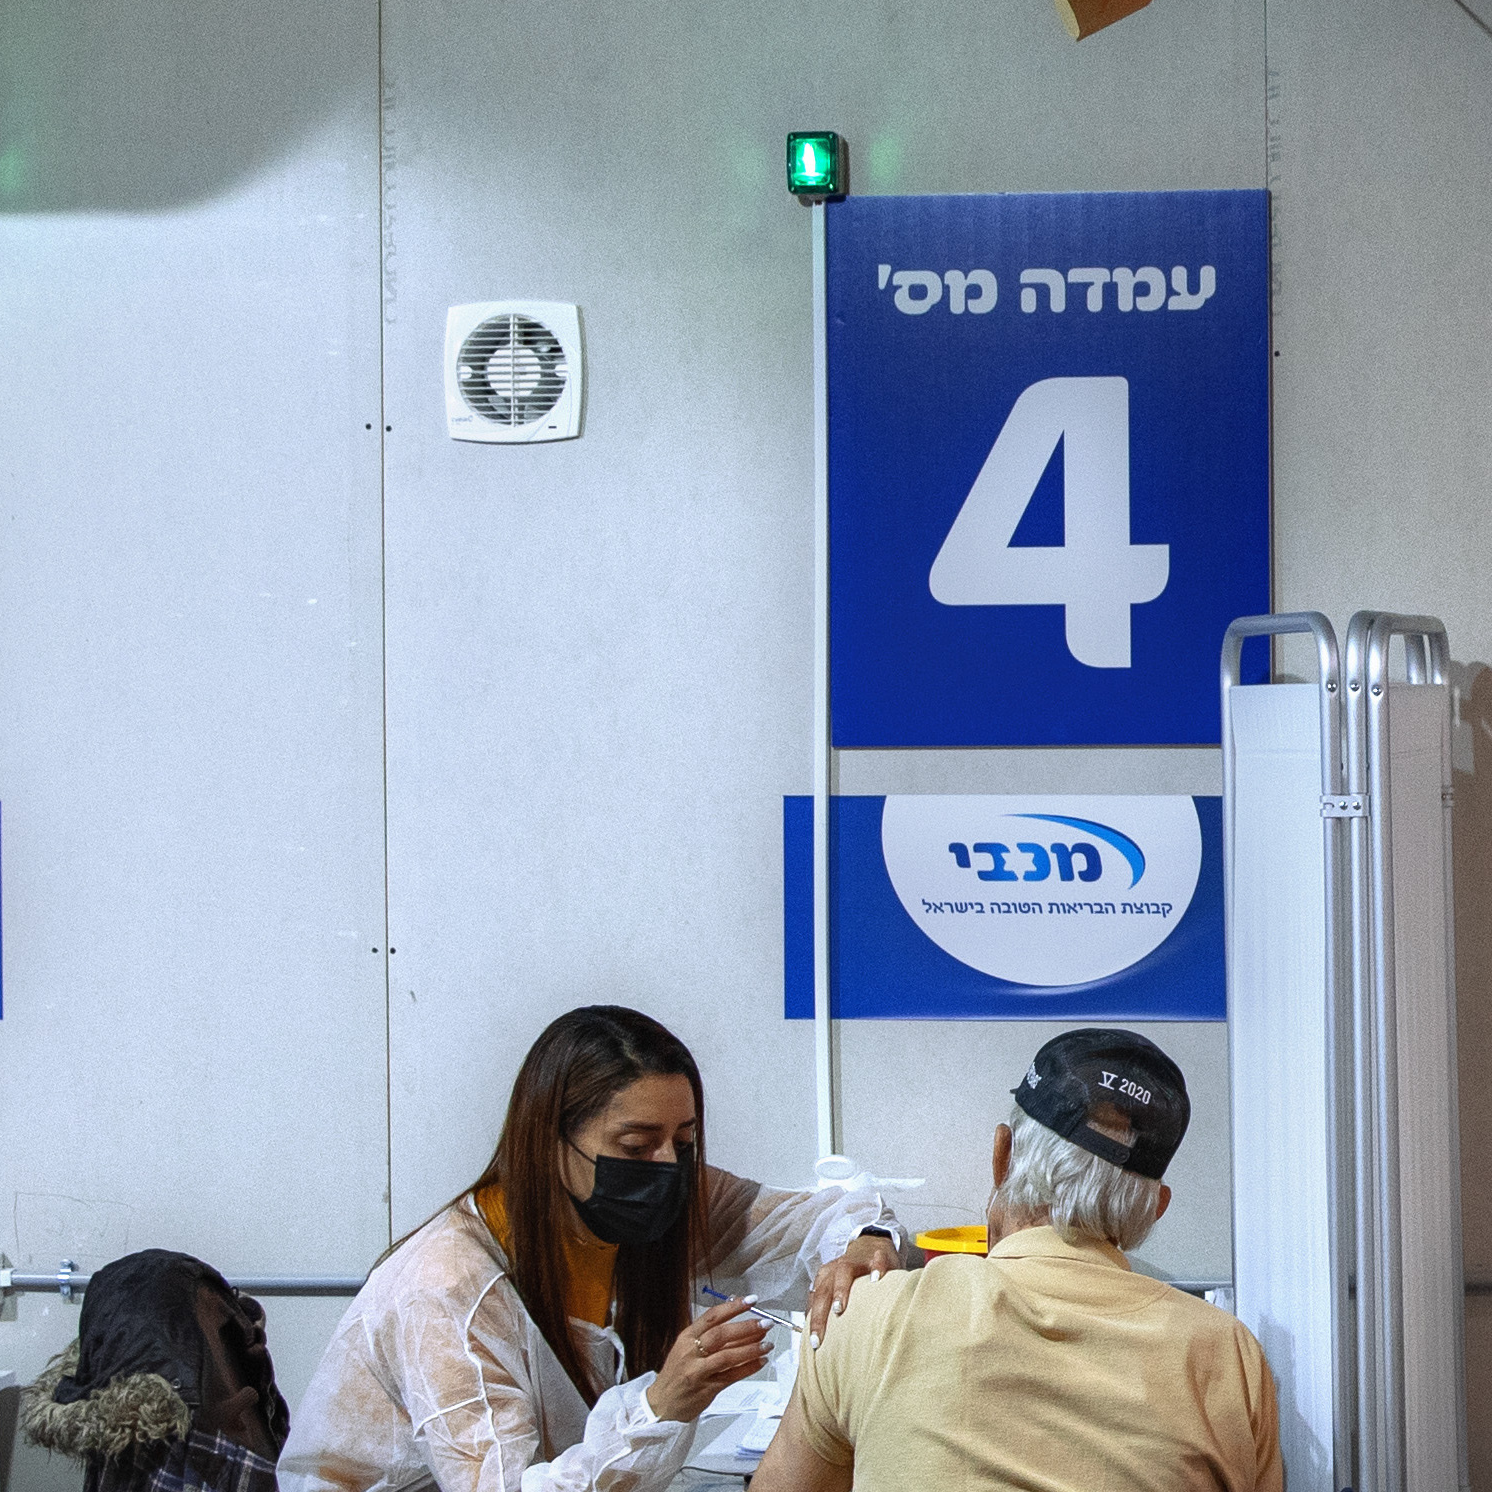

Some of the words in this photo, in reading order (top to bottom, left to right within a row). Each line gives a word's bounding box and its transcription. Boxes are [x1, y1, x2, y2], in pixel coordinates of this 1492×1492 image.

[878, 264, 998, 314] מס'
[1020, 263, 1216, 313] עמדה
[928, 375, 1170, 669] 4
[948, 842, 1102, 882] מכבי
[921, 898, 985, 915] בישראל
[990, 901, 1043, 914] הטובה
[1048, 901, 1116, 914] הבריאות
[1121, 902, 1174, 919] קבוצת
[1119, 1078, 1151, 1105] 2020
